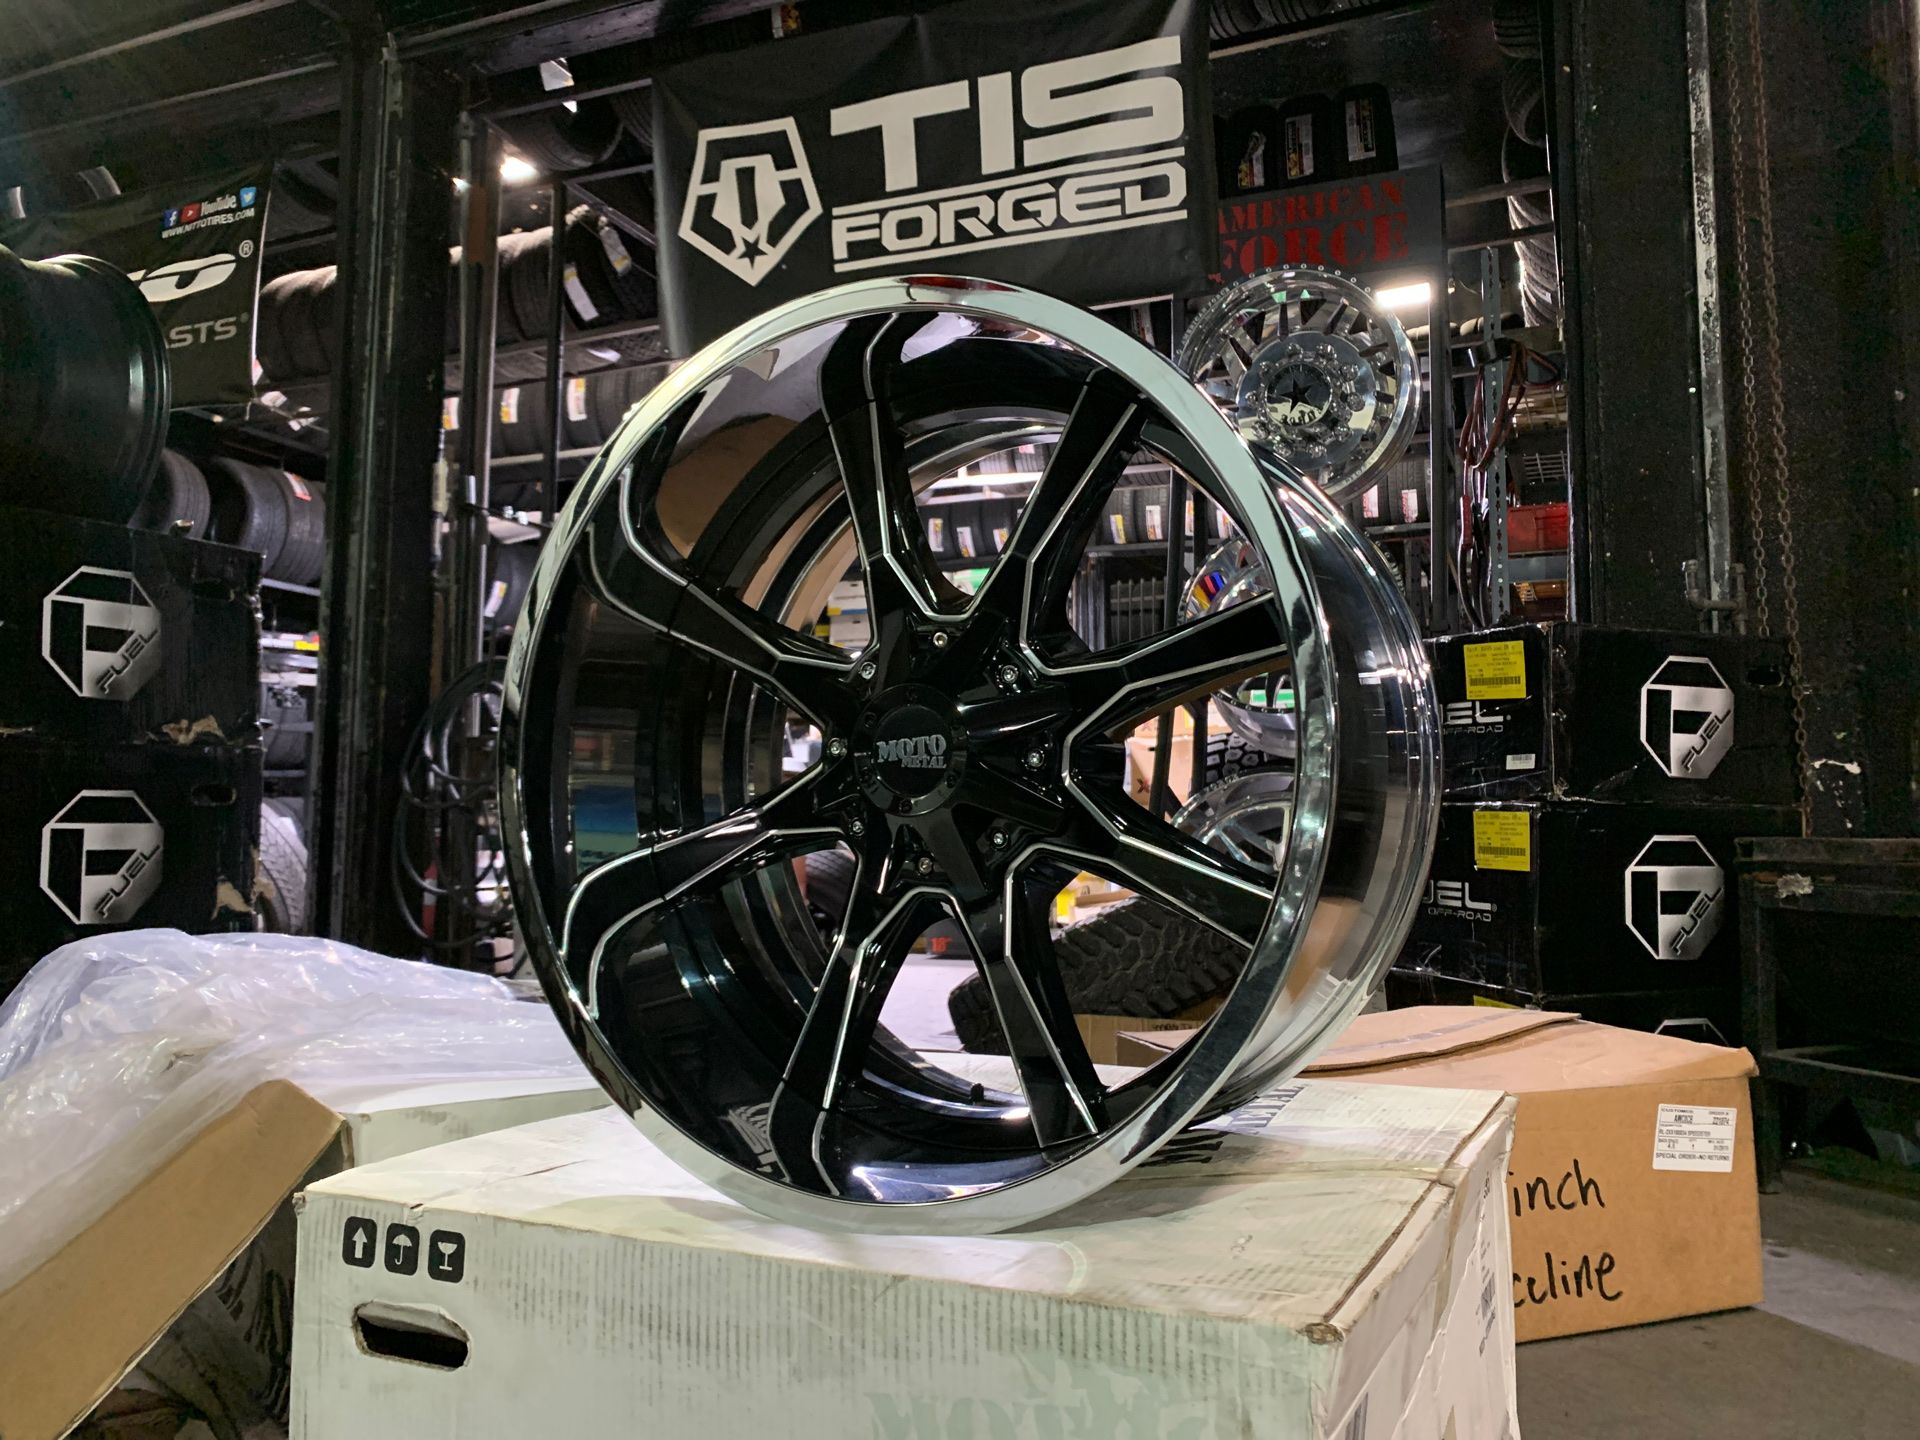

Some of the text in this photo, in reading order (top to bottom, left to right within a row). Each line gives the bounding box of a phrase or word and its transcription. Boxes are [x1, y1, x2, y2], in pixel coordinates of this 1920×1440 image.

[829, 36, 1184, 193] TIS
[161, 207, 255, 239] WWW.NITTOTIRES.COM
[200, 193, 238, 217] YouTube
[832, 161, 1188, 261] FORGED
[1218, 177, 1406, 235] AMERICAN
[95, 628, 158, 695] FUEL
[1440, 701, 1504, 725] EL
[1680, 707, 1732, 775] FUEL
[875, 734, 947, 763] MOTO
[900, 755, 948, 769] METAL
[94, 843, 162, 919] FUEL
[1670, 886, 1725, 956] FUEL
[1655, 1152, 1677, 1160] SPECIAL
[1508, 1158, 1606, 1217] inch
